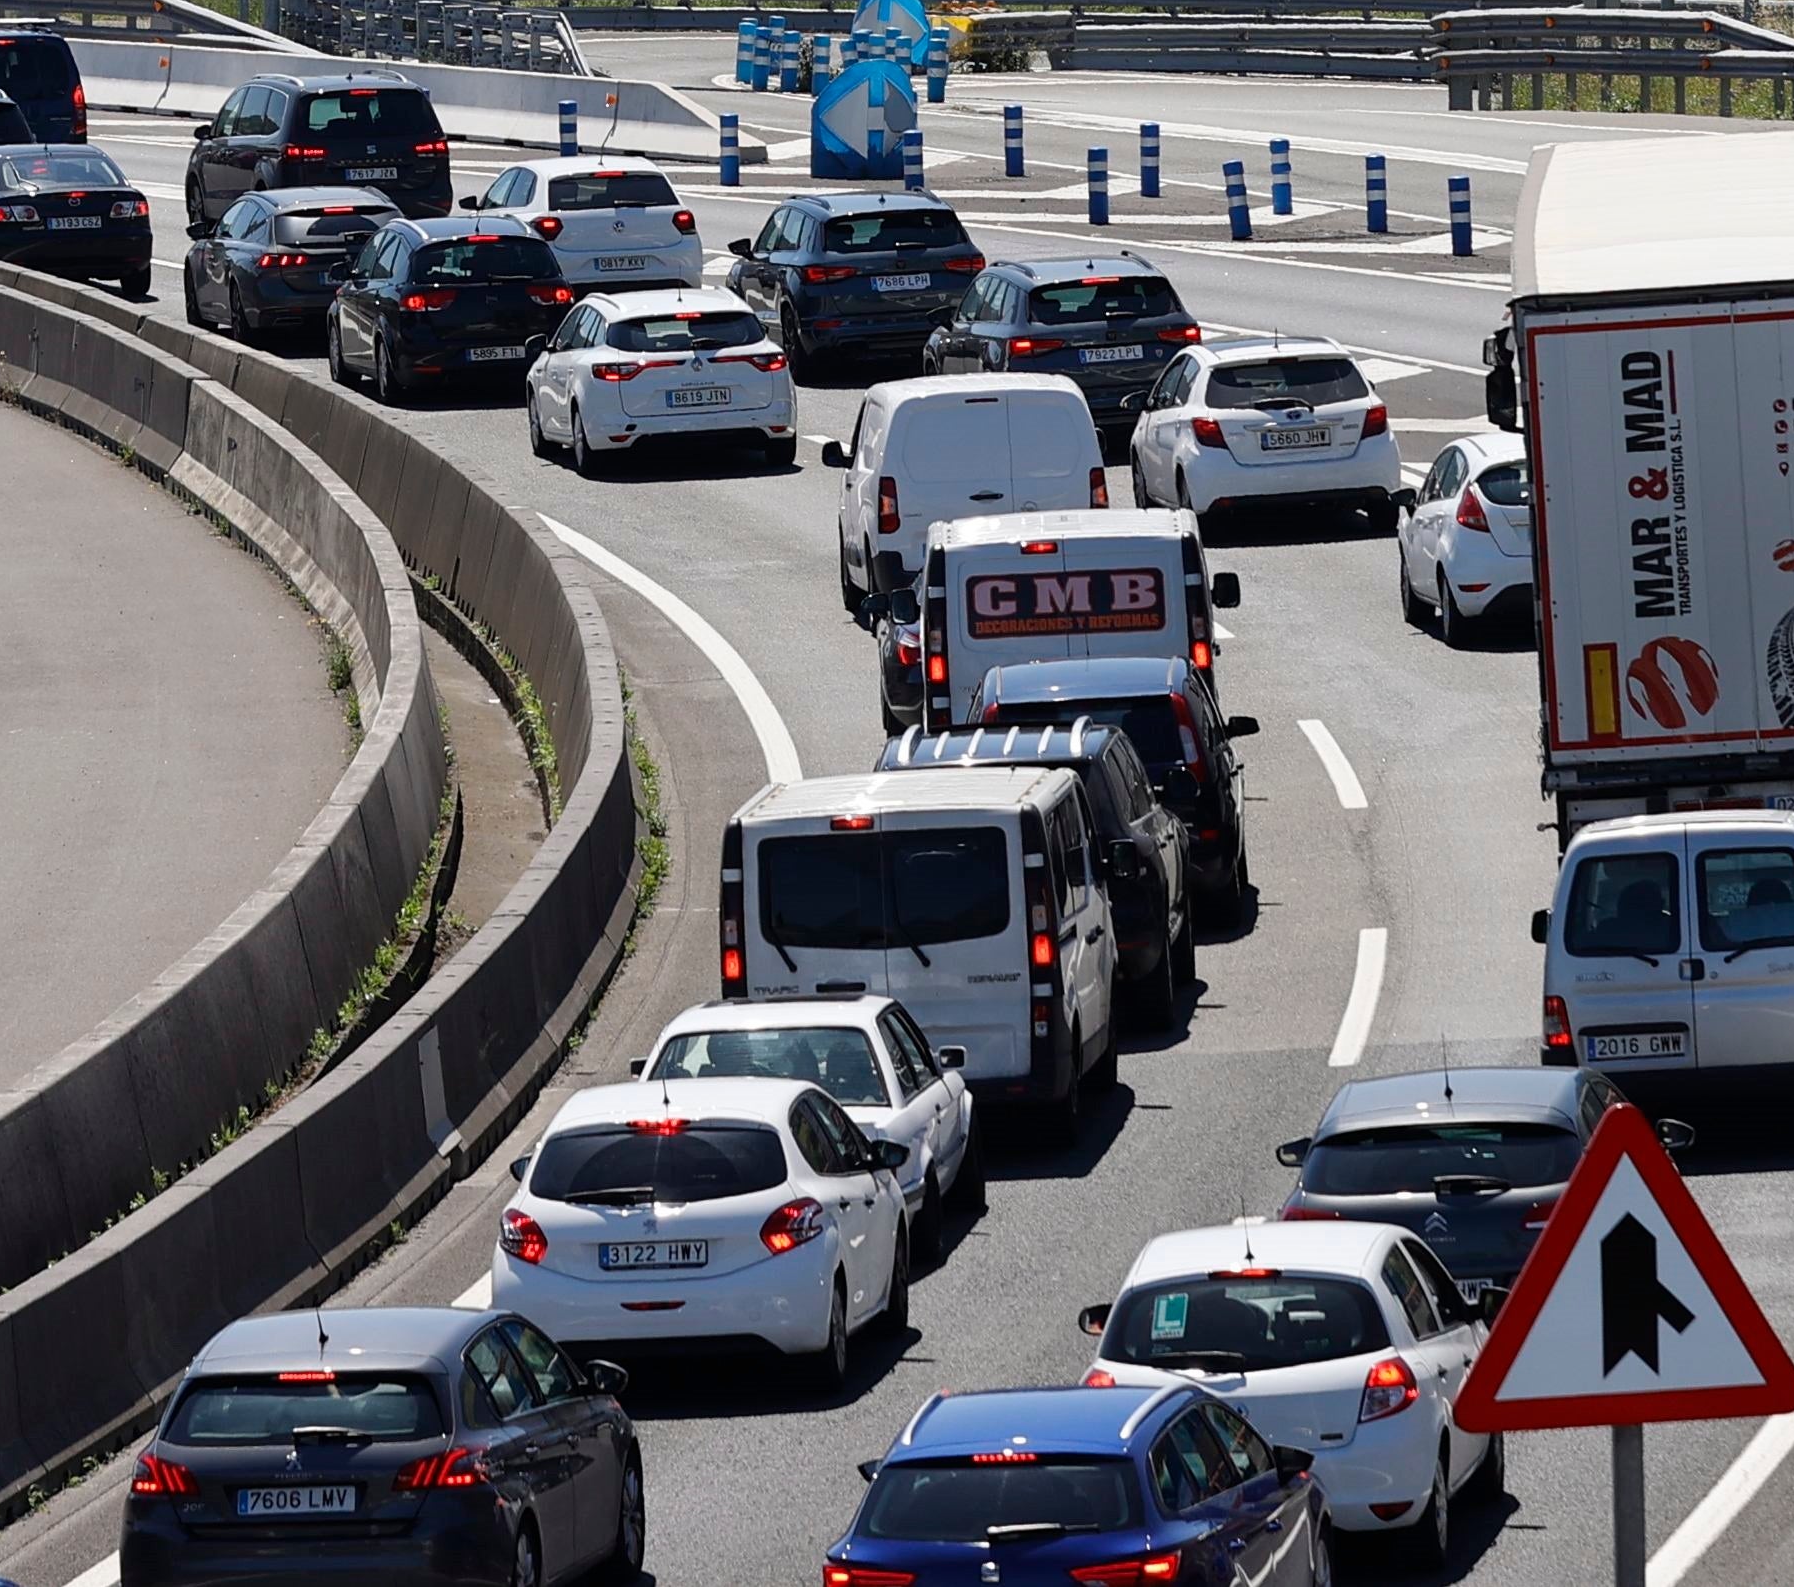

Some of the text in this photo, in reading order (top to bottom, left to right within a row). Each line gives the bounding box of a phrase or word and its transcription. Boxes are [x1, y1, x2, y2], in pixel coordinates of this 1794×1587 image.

[351, 170, 375, 179] 7617
[600, 258, 624, 268] 0817
[878, 276, 928, 288] 7686 LPH
[473, 348, 498, 358] 5895
[1087, 348, 1140, 360] 7922 LPL
[675, 390, 727, 403] 8619 JTN
[1270, 433, 1301, 445] 5660
[1621, 351, 1676, 618] MAR & MAD
[1670, 419, 1692, 616] TRANSPORTES Y LOGISTICA S.L.
[976, 612, 1159, 634] DECORACIONES Y REFORMAS
[1597, 1033, 1681, 1055] 2016 GWW
[610, 1243, 703, 1264] 3122 HWY
[1157, 1299, 1181, 1328] L
[250, 1489, 348, 1510] 7606 LMV
